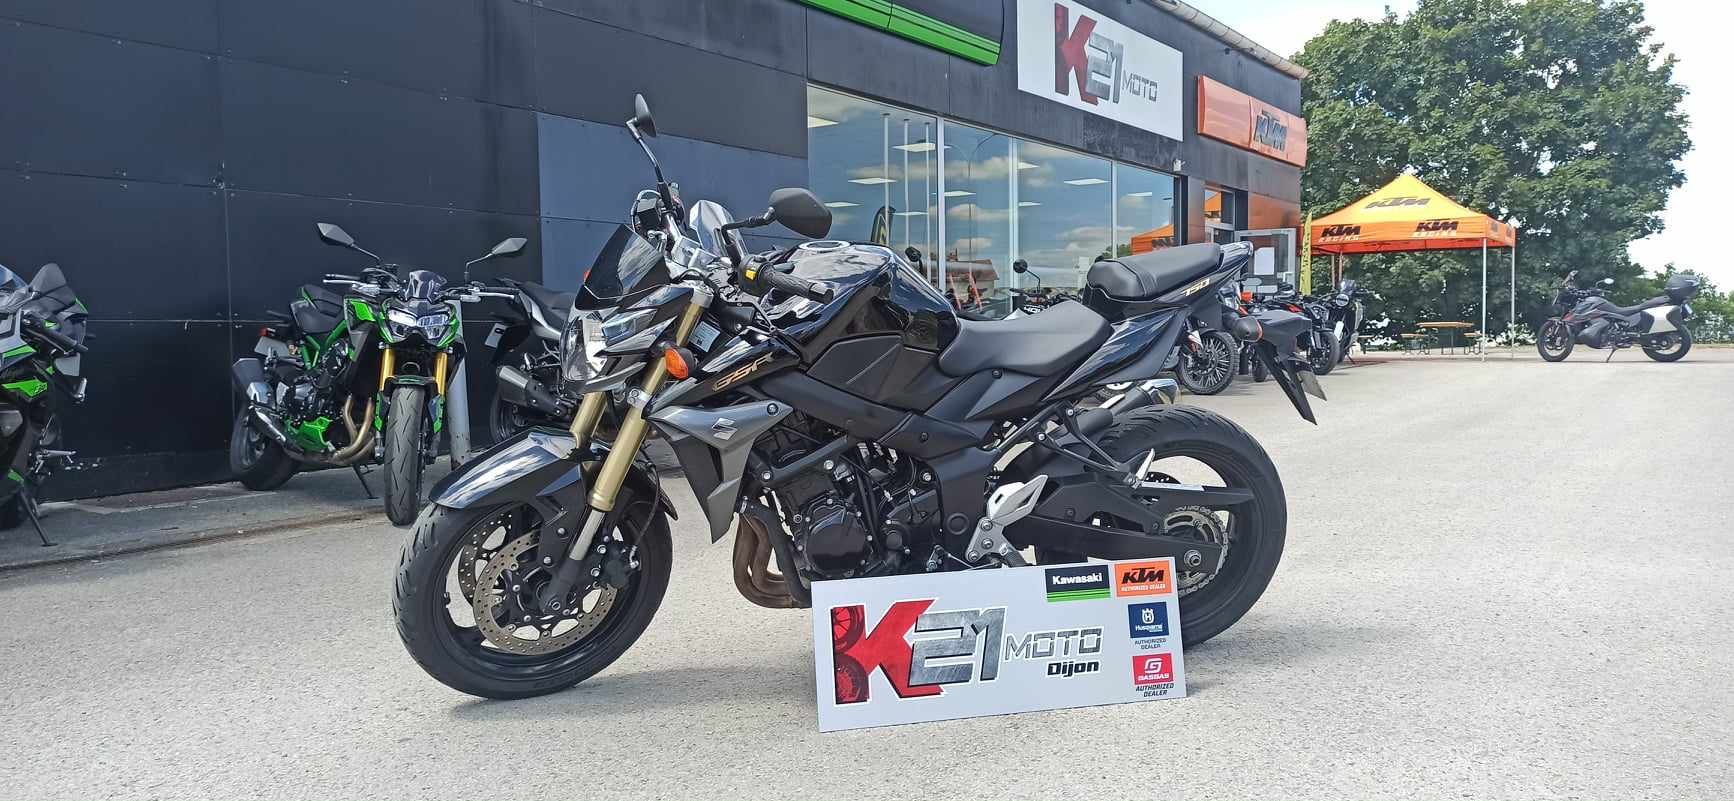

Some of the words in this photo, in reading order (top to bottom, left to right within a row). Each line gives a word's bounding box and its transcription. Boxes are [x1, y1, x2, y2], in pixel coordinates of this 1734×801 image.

[1055, 2, 1124, 106] K21
[1122, 70, 1158, 102] MOTO
[1253, 109, 1288, 152] KTM
[1365, 196, 1431, 209] KTM
[1321, 224, 1361, 237] KTM
[1416, 218, 1459, 232] KTM
[1181, 278, 1210, 297] 750
[712, 352, 775, 392] GSR
[1052, 572, 1103, 585] Kawasaki
[1121, 567, 1165, 584] KTM
[1135, 638, 1167, 646] AUTHORIZED
[831, 599, 1006, 704] K21
[1004, 628, 1102, 661] MOTO
[1047, 661, 1099, 678] Dijon
[1136, 684, 1174, 692] AUTHORIZED
[1144, 689, 1168, 697] DEALER
